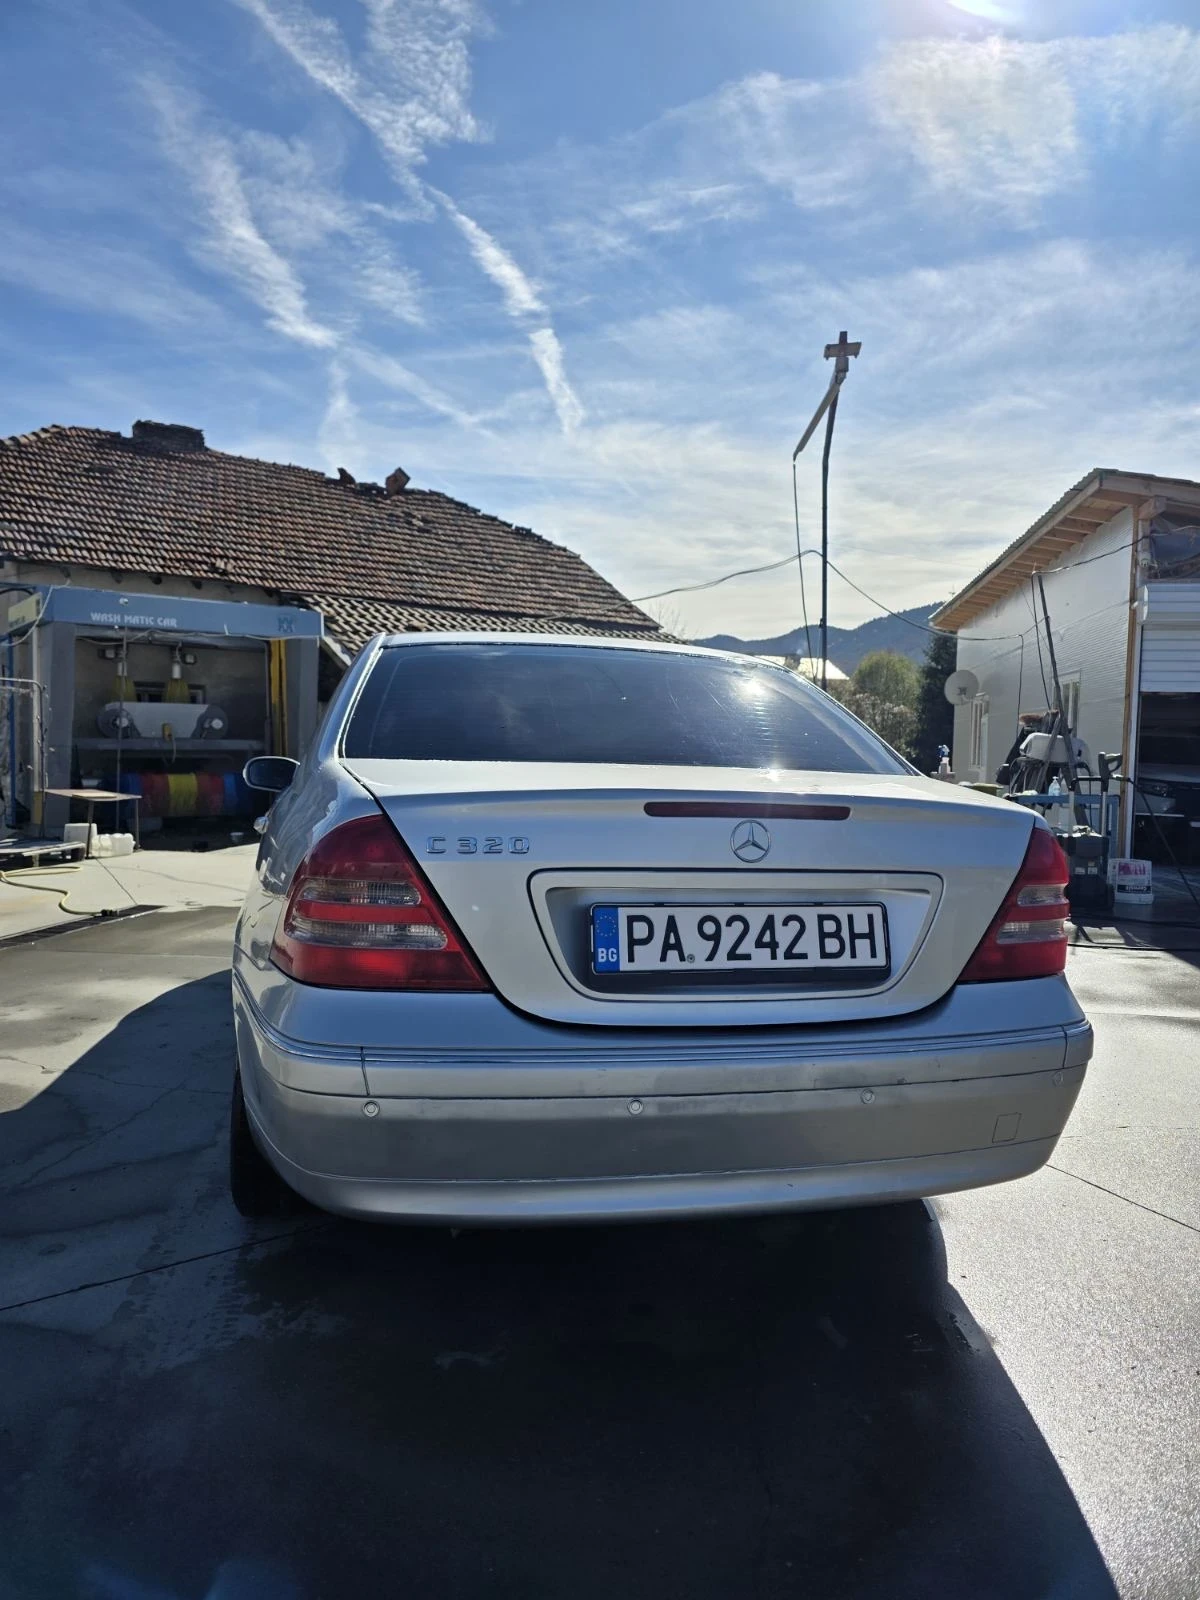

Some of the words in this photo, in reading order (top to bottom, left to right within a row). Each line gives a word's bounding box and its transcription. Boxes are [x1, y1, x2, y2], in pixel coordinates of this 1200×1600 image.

[90, 612, 120, 623] WASH
[123, 614, 154, 625] MATIC
[156, 617, 177, 628] CAR
[426, 836, 447, 854] C
[457, 836, 530, 854] 320
[626, 914, 686, 963] PA
[697, 914, 809, 962] 9242
[816, 913, 878, 960] BH
[598, 947, 618, 963] BG
